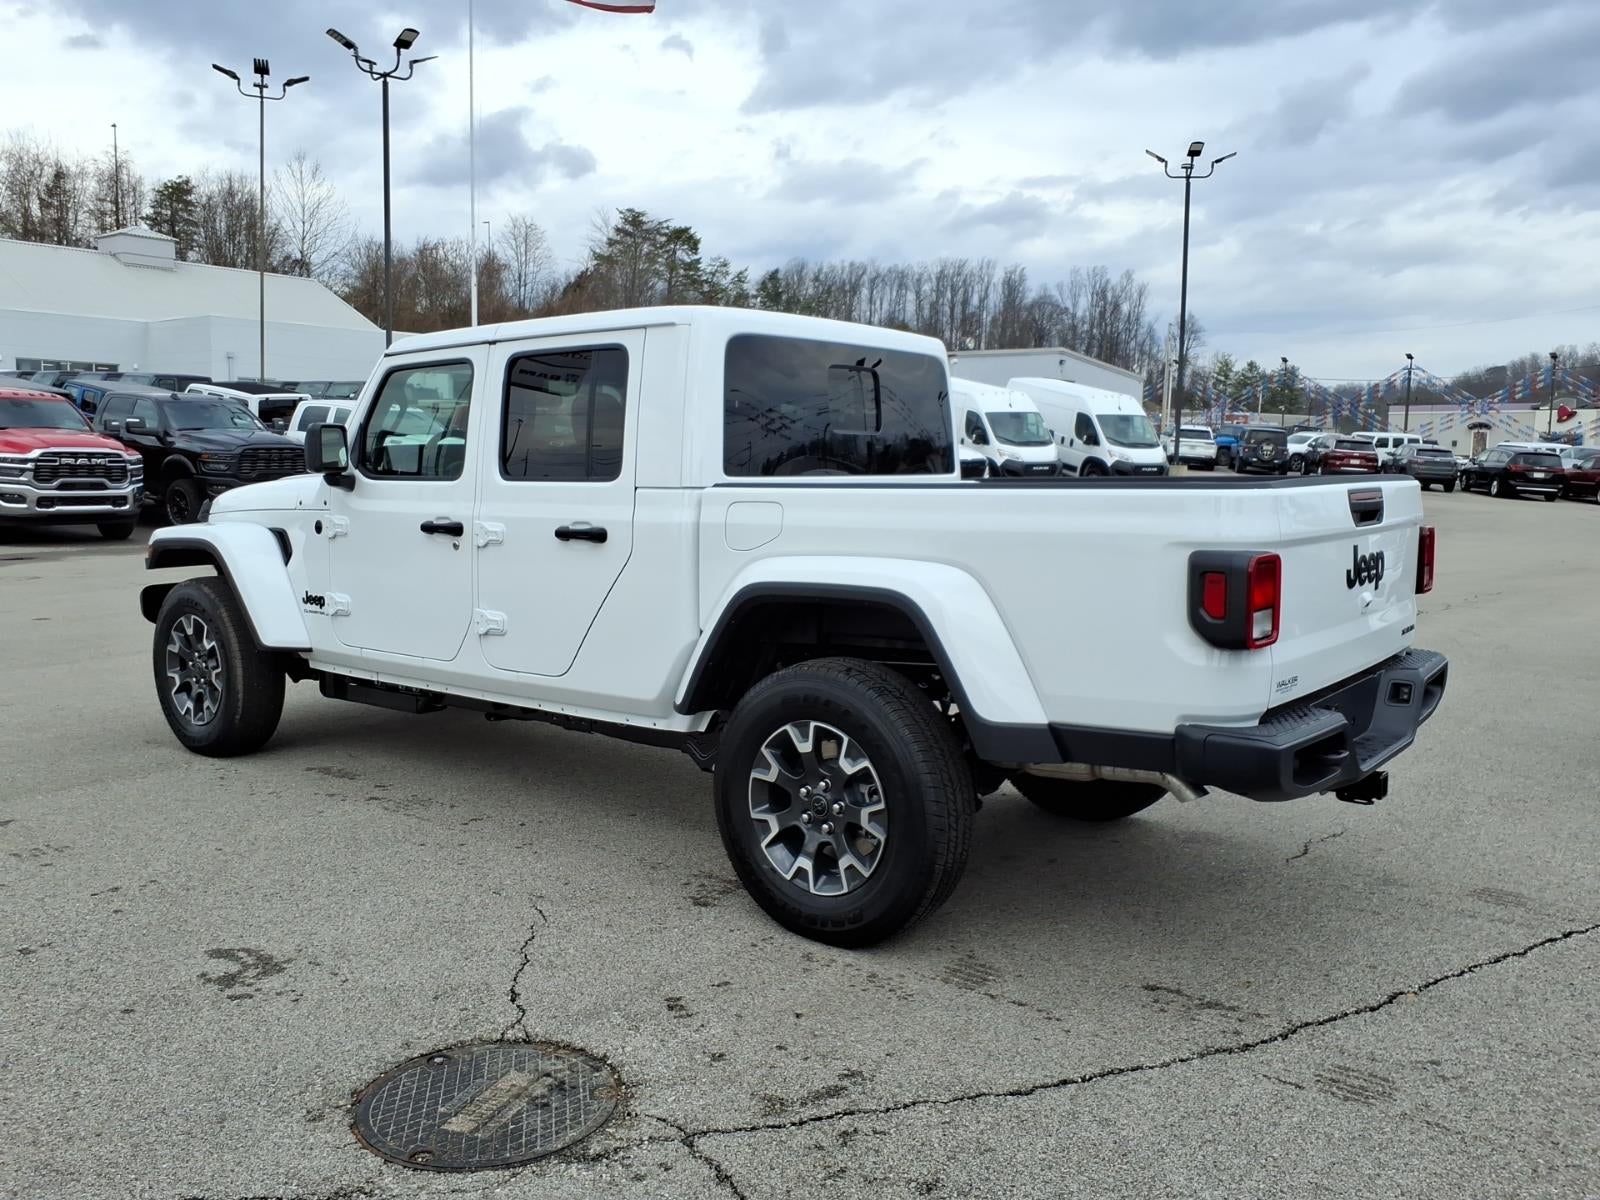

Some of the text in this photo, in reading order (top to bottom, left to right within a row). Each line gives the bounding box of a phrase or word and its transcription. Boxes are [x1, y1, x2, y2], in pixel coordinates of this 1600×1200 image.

[60, 457, 106, 465] RAM
[1346, 544, 1385, 591] Jeep
[302, 590, 326, 610] Jeep
